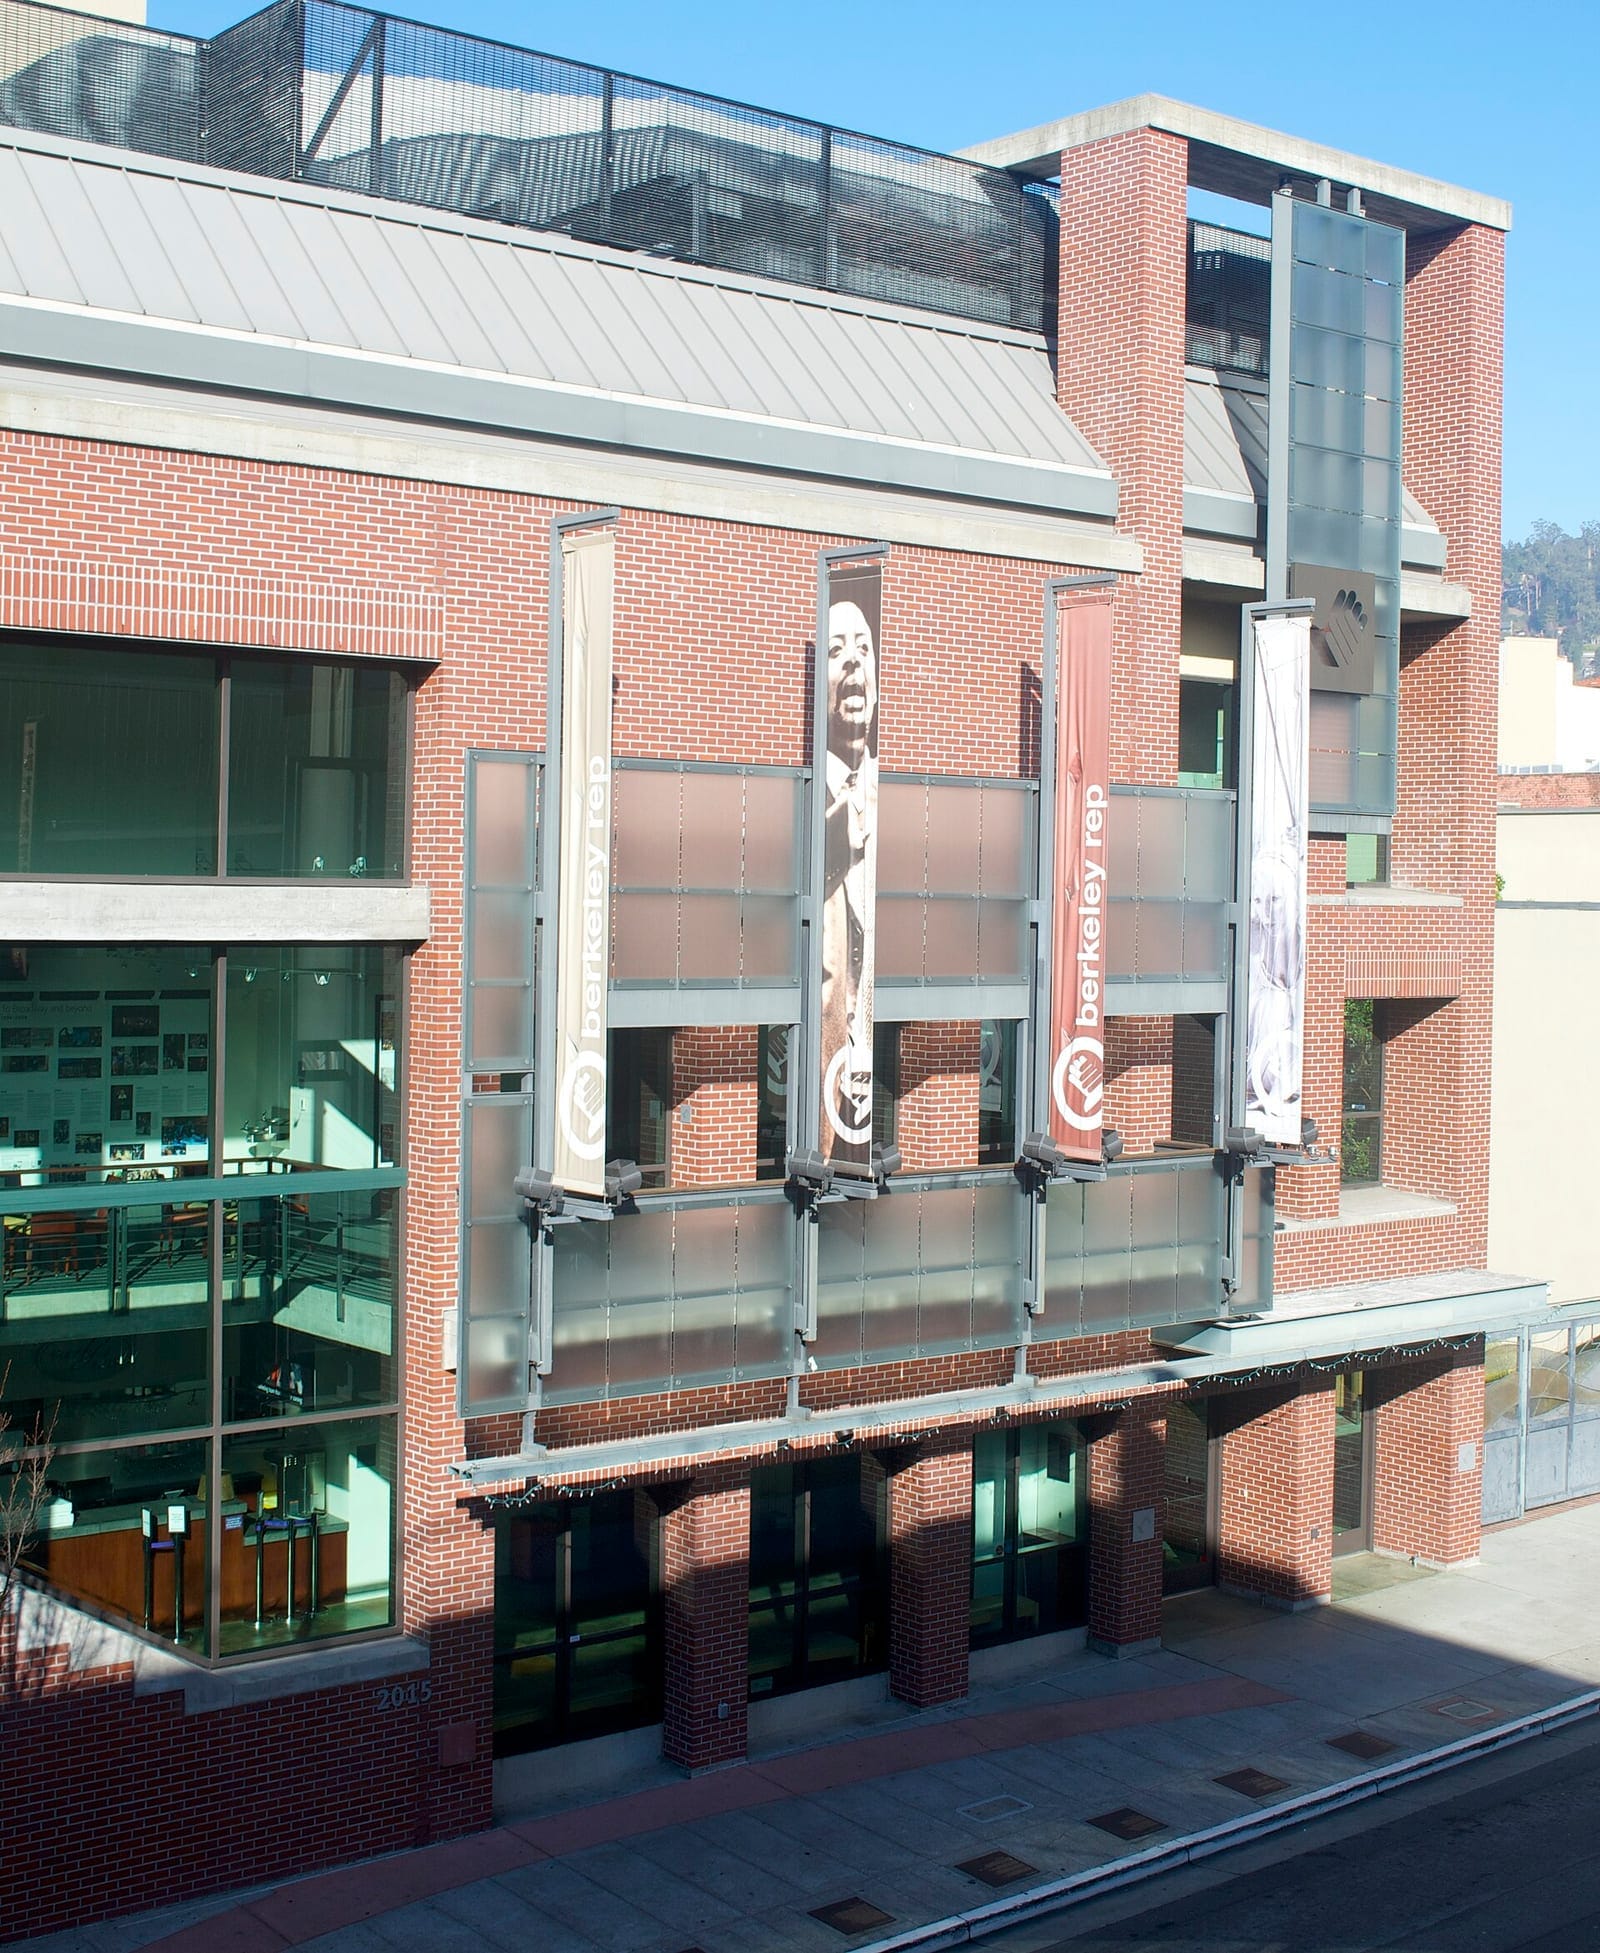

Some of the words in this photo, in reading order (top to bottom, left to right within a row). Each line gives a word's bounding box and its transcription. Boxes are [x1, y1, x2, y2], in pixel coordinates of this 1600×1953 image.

[588, 755, 610, 828] rep
[1085, 784, 1109, 848] rep
[581, 840, 609, 1038] berkeley
[1075, 858, 1107, 1027] berkeley
[376, 1680, 432, 1710] 2015
